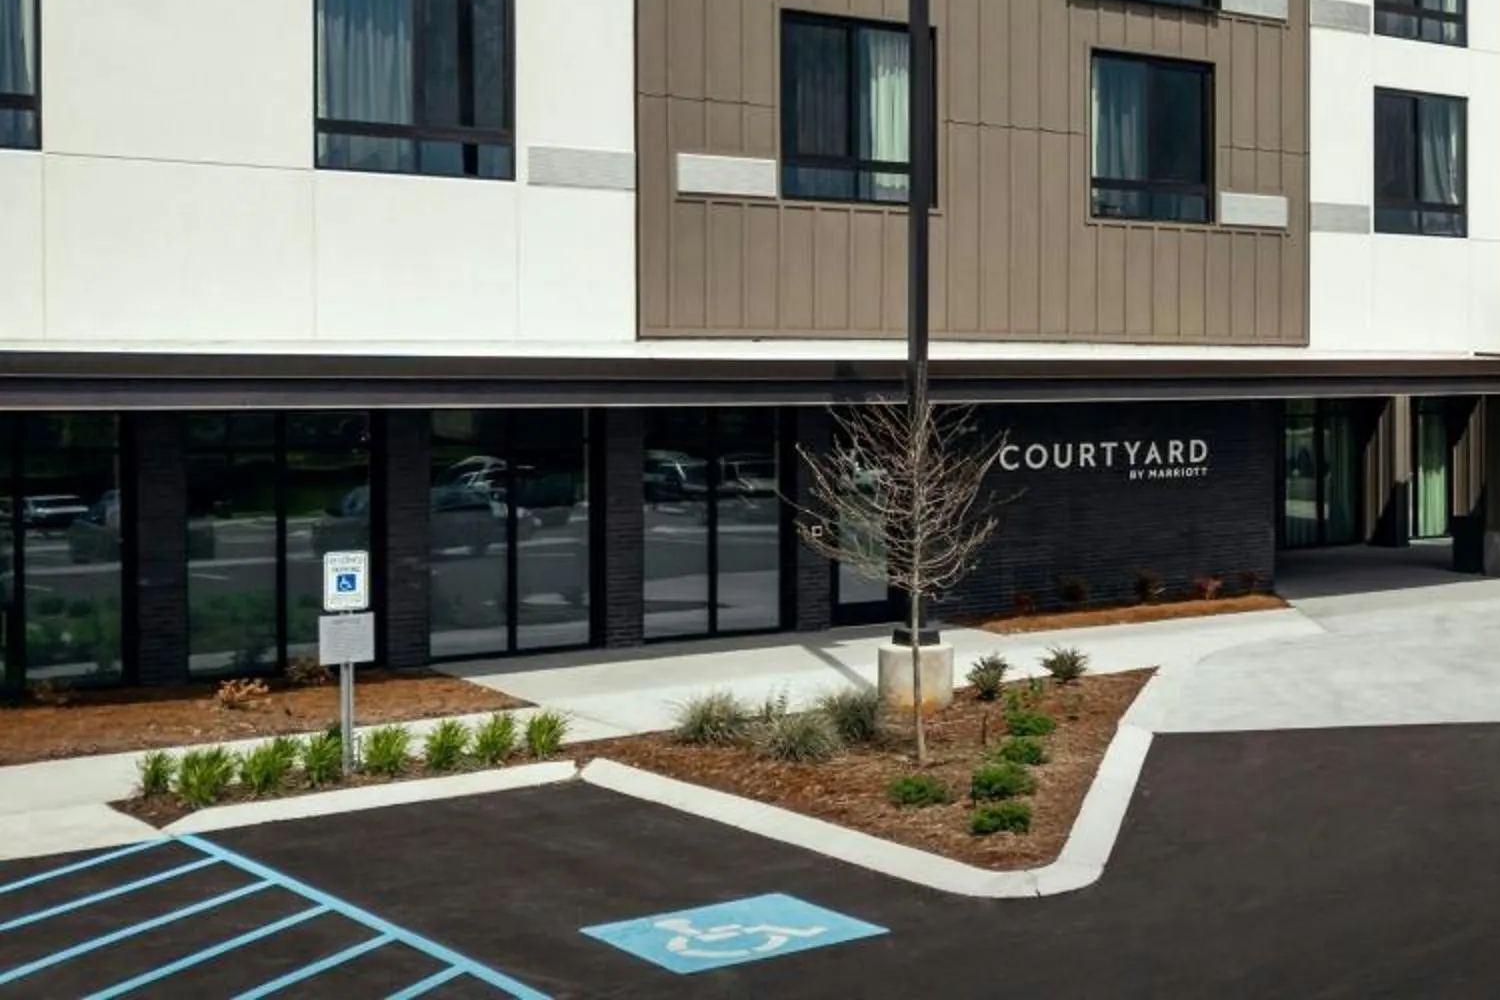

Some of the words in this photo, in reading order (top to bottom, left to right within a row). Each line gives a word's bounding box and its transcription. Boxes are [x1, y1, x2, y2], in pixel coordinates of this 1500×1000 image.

[1000, 439, 1208, 470] COURTYARD
[1129, 469, 1144, 480] BY
[1148, 467, 1207, 479] MARRIOTT
